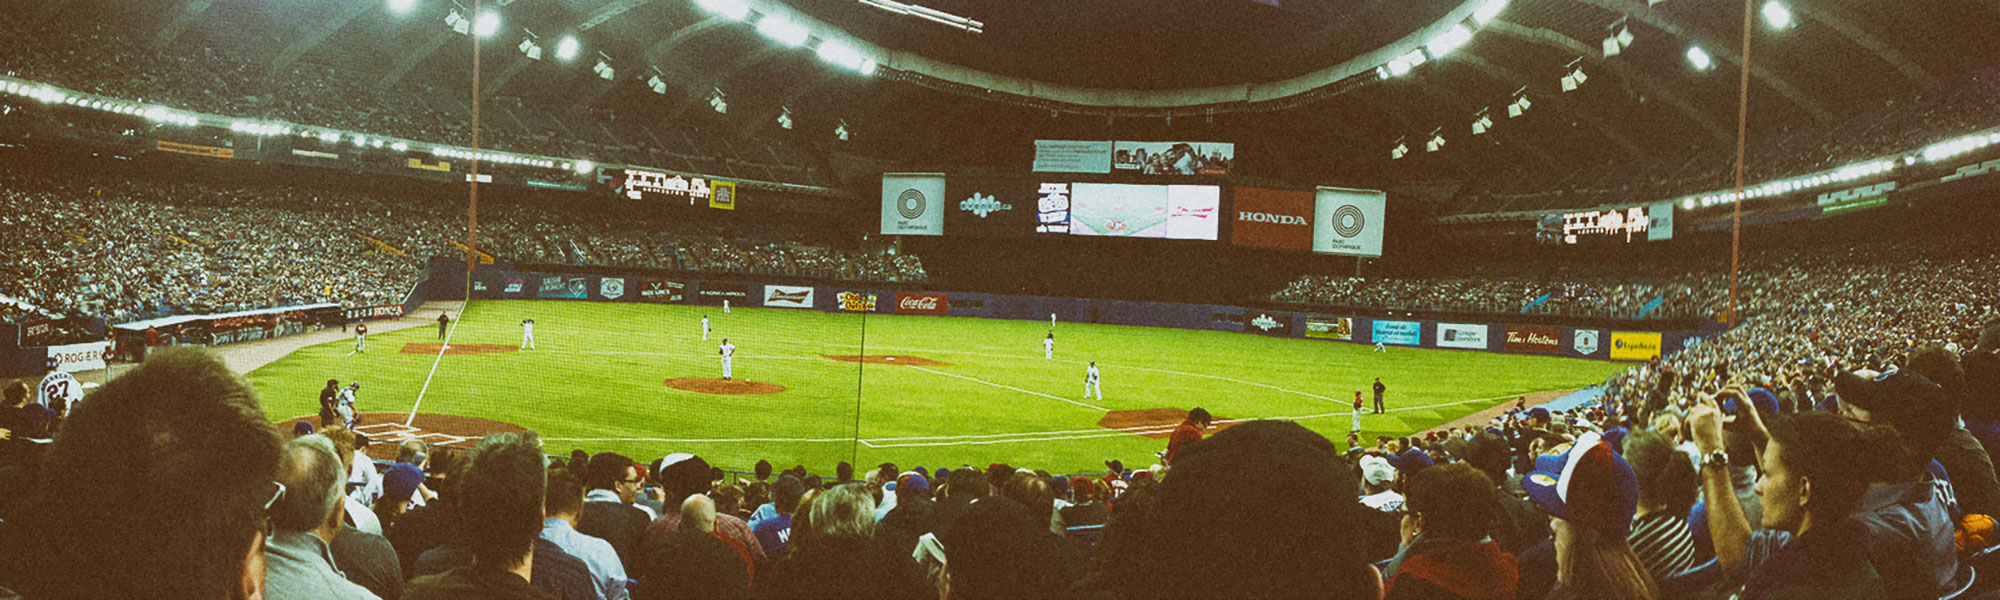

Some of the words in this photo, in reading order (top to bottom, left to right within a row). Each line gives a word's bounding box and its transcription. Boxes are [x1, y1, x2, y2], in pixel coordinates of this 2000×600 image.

[1238, 211, 1308, 226] HONDA
[1527, 332, 1559, 346] Hortons
[46, 380, 69, 401] 27
